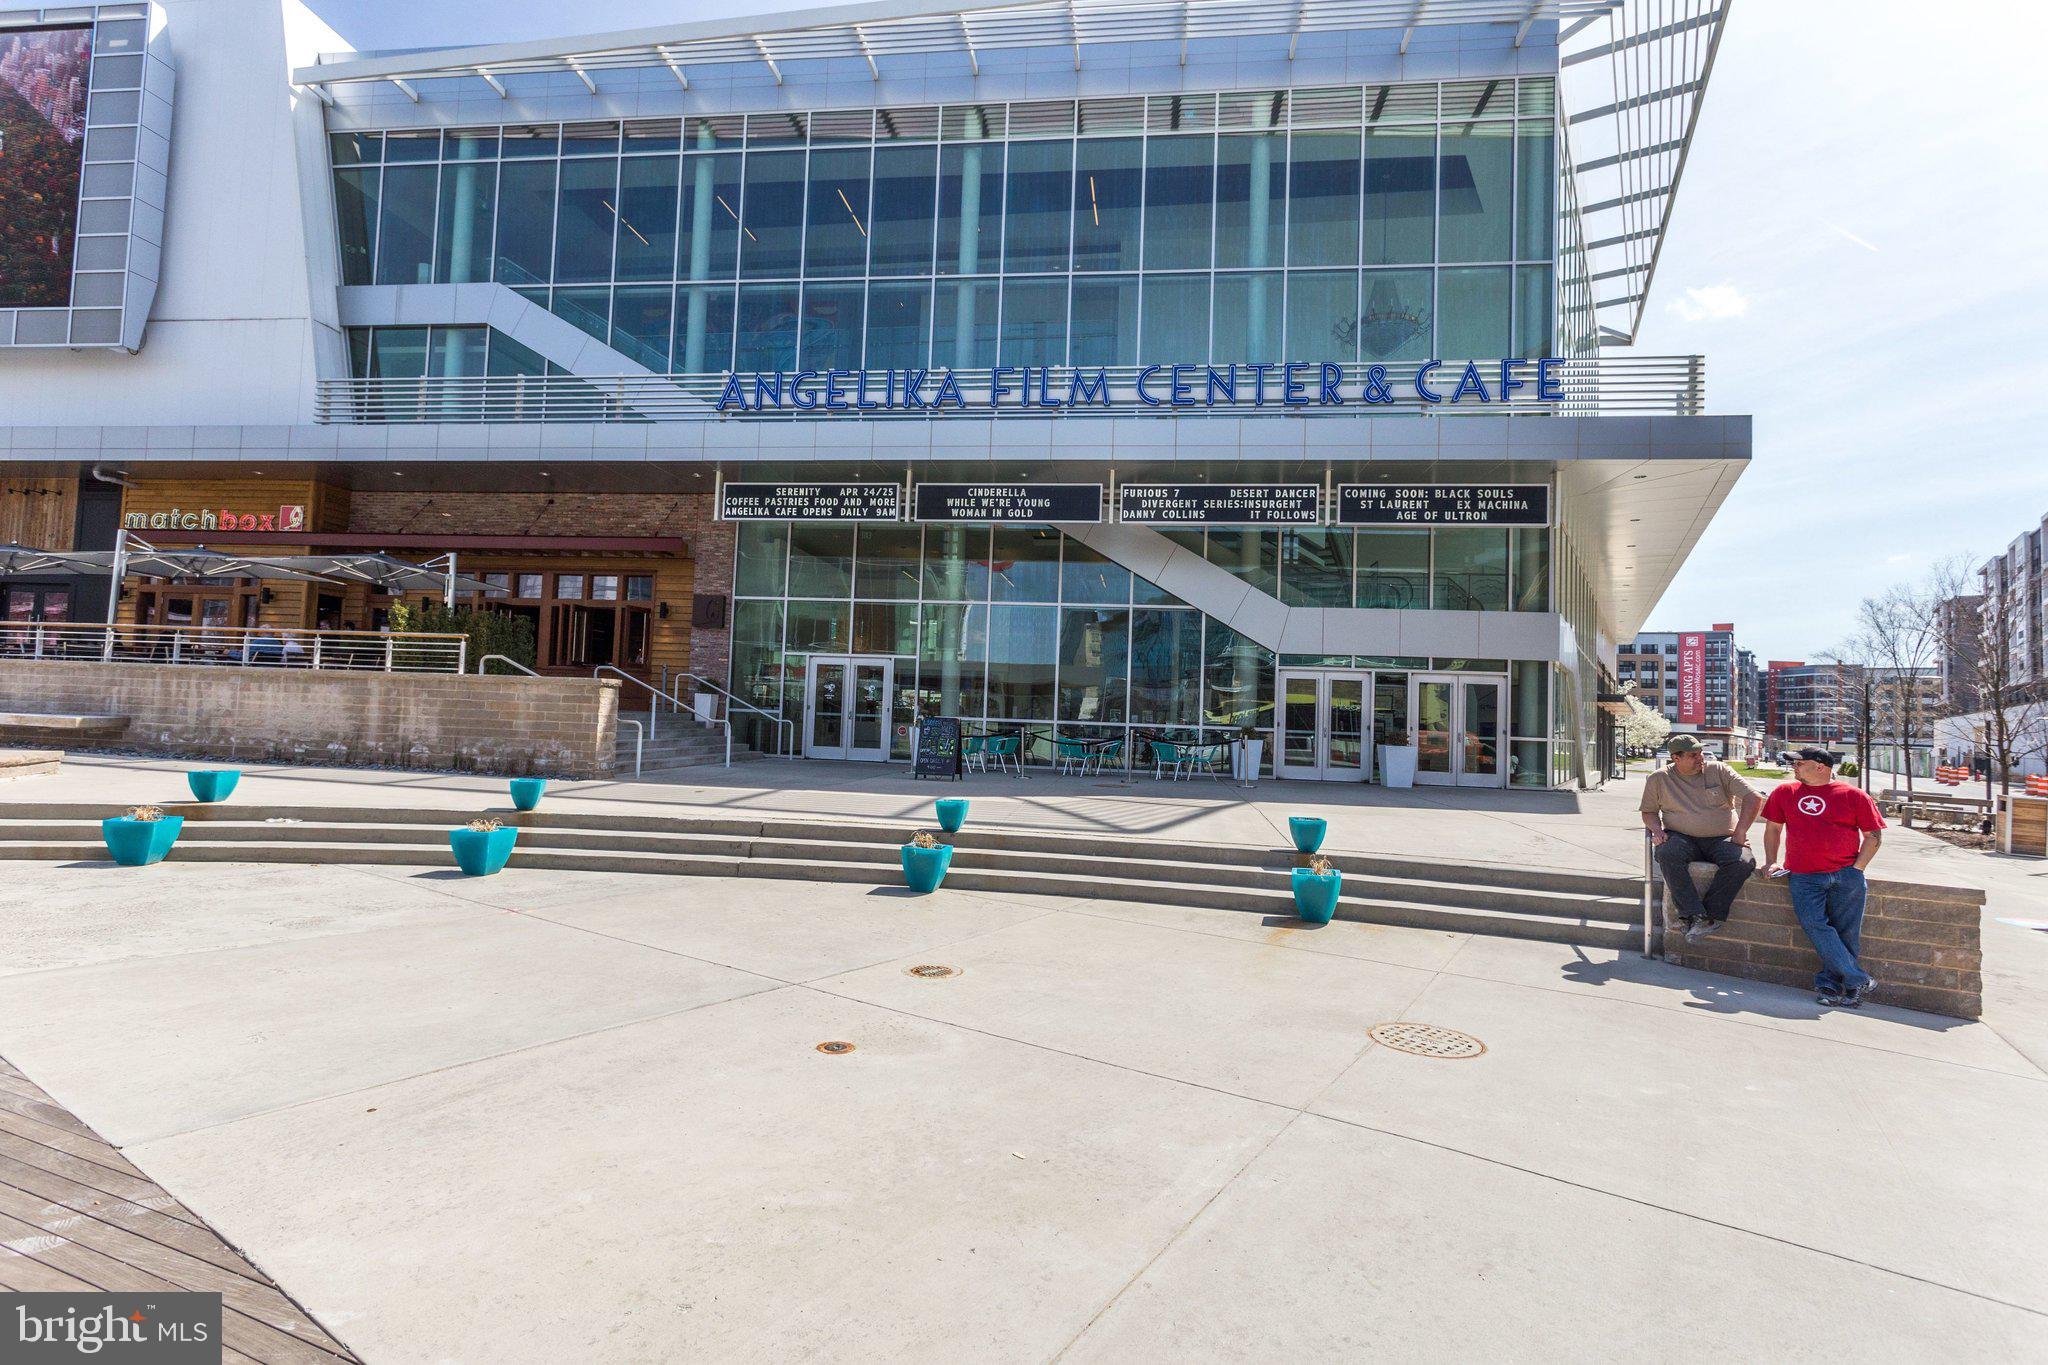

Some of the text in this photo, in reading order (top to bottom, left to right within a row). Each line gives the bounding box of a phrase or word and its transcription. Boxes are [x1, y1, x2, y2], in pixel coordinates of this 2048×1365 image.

[717, 357, 1567, 411] ANGELIKA FILM CENTER & CAFE
[775, 488, 821, 496] SERENITY
[839, 488, 894, 496] APR 24/25
[967, 488, 1027, 497] CINDERELLA
[1123, 489, 1180, 498] FURIOUS 7
[1230, 489, 1316, 498] DESERT DANCER
[1344, 489, 1429, 499] COMING SOON:
[1434, 489, 1514, 499] BLACK SOULS
[725, 497, 896, 506] COFFEE PASTRIES FOOD AND MORE
[947, 498, 976, 507] WHILE
[1017, 498, 1050, 507] YOUNG
[1141, 499, 1198, 508] DIVERGENT
[1360, 500, 1430, 509] ST LAURENT
[1457, 500, 1529, 510] EX MACHINA
[725, 507, 770, 516] ANGELIKA
[775, 507, 797, 516] CAFE
[802, 507, 833, 516] OPENS
[876, 507, 896, 516] 9AM
[951, 508, 1033, 517] WOMAN IN GOLD
[1123, 510, 1205, 519] DANNY COLLINS
[1250, 510, 1316, 519] IT FOLLOWS
[1396, 511, 1488, 520] AGE OF ULTRON
[124, 507, 275, 532] matchbox
[1683, 650, 1694, 716] LEASING APTS
